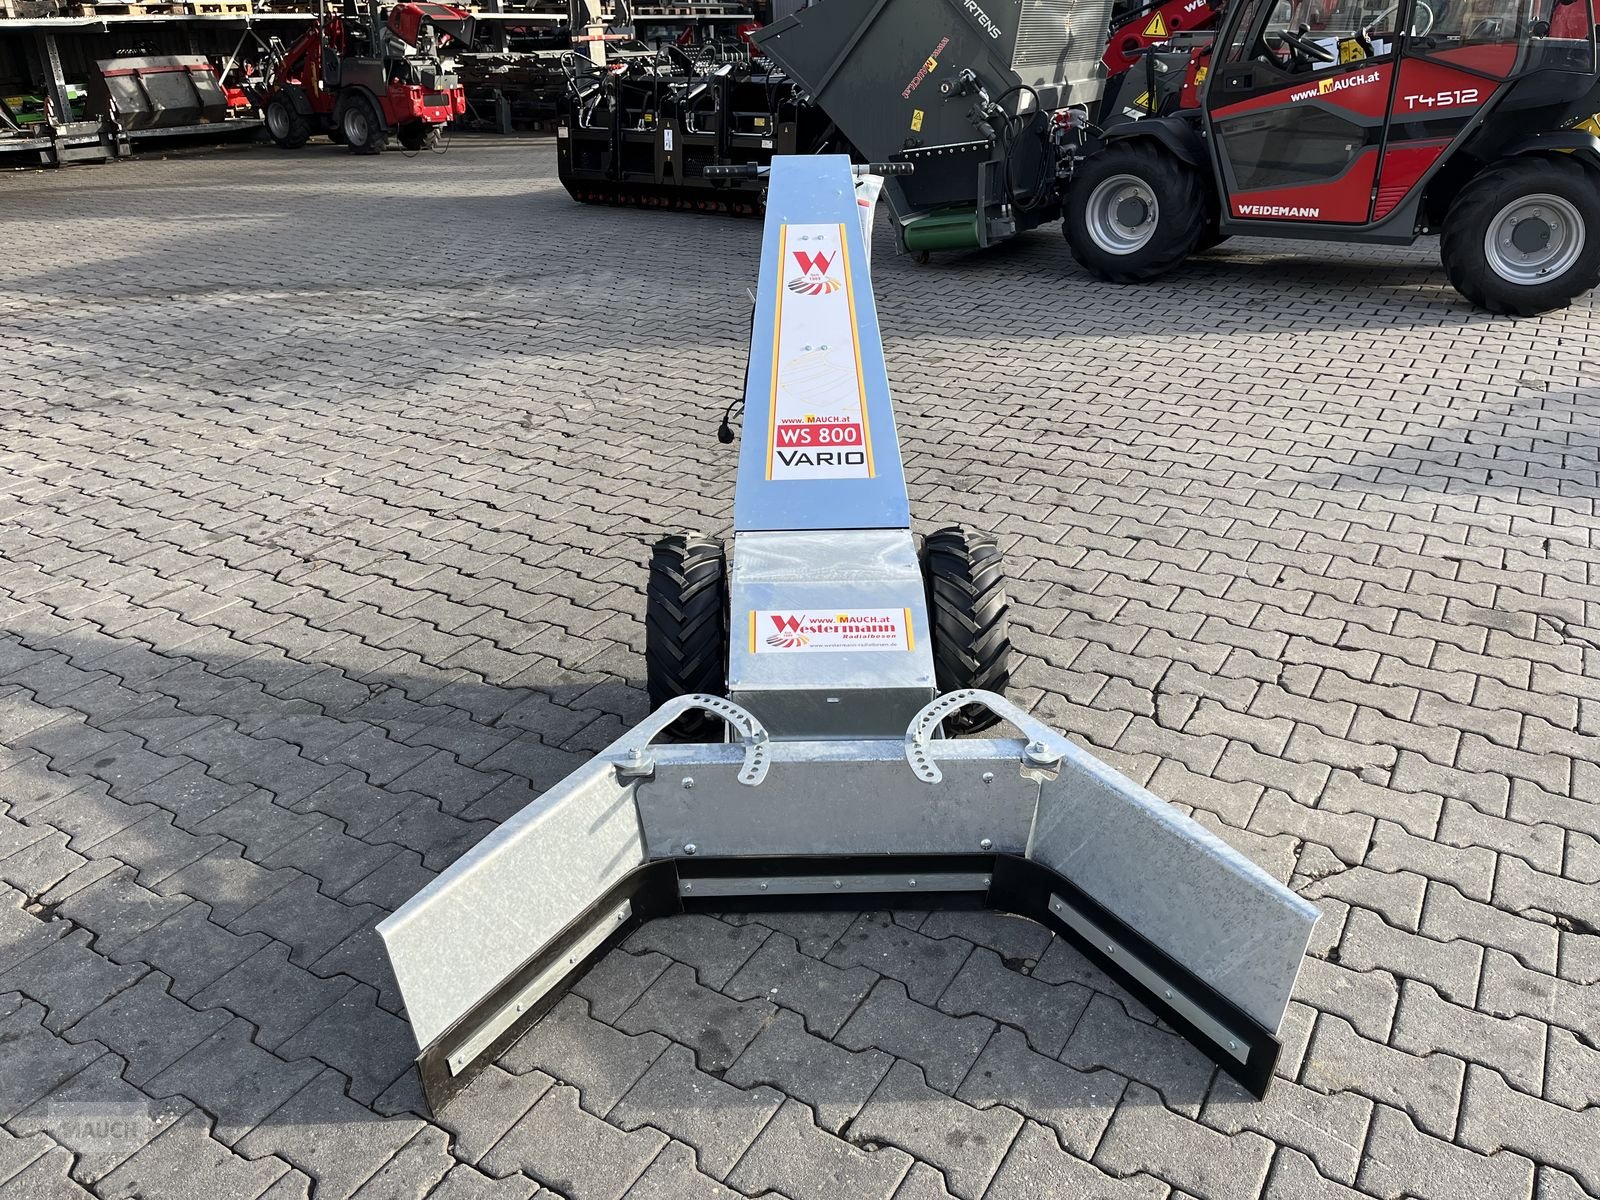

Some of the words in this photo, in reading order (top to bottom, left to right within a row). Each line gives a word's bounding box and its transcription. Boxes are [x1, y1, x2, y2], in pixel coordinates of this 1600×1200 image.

[1290, 71, 1380, 102] www.MAUCH.at
[1404, 88, 1479, 109] T4512
[1238, 204, 1320, 218] WEIDEMANN
[780, 428, 812, 444] WS
[819, 427, 857, 443] 800
[776, 450, 865, 467] VARIO
[770, 615, 896, 633] Westermann
